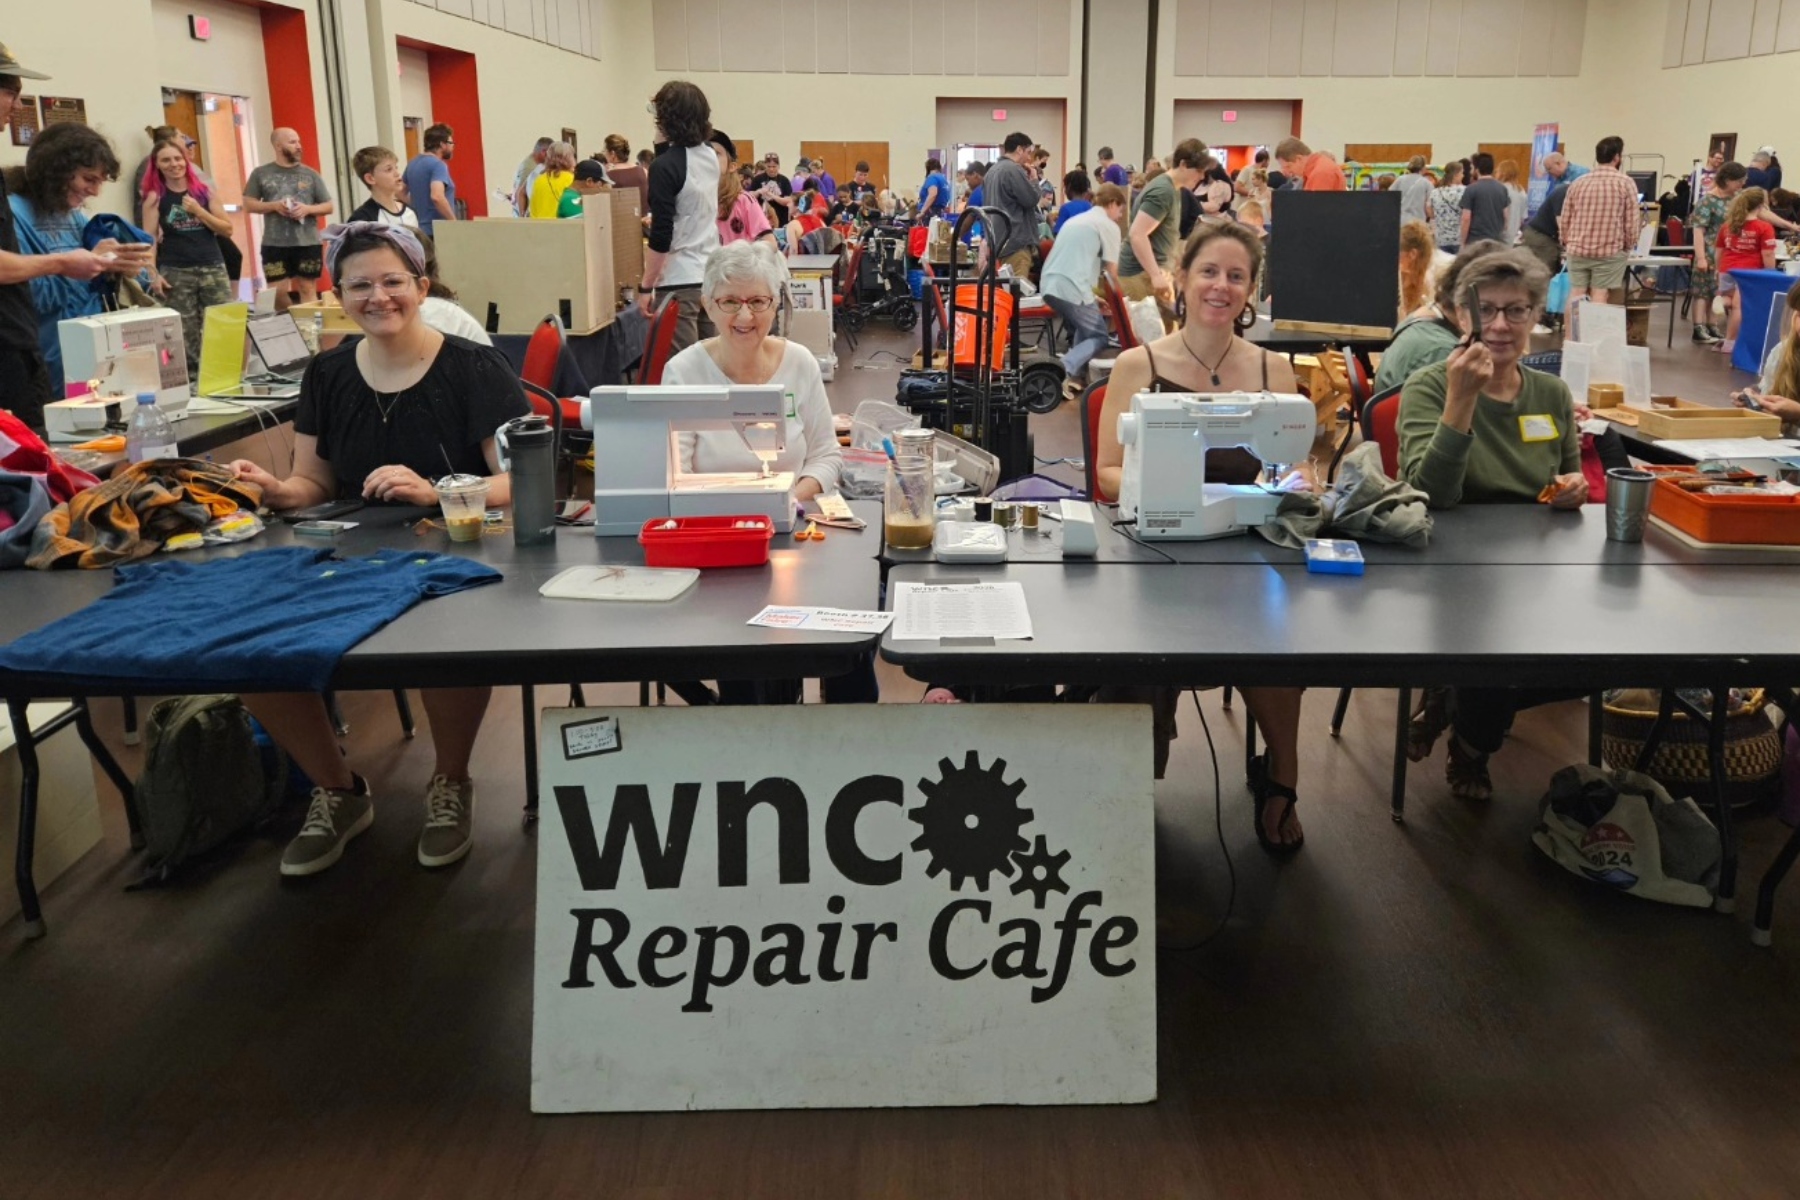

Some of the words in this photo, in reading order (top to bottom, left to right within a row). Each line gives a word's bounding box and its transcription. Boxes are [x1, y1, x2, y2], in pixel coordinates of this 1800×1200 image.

[554, 775, 904, 890] wnc
[561, 895, 898, 1013] Repair
[928, 890, 1139, 1004] Cafe
